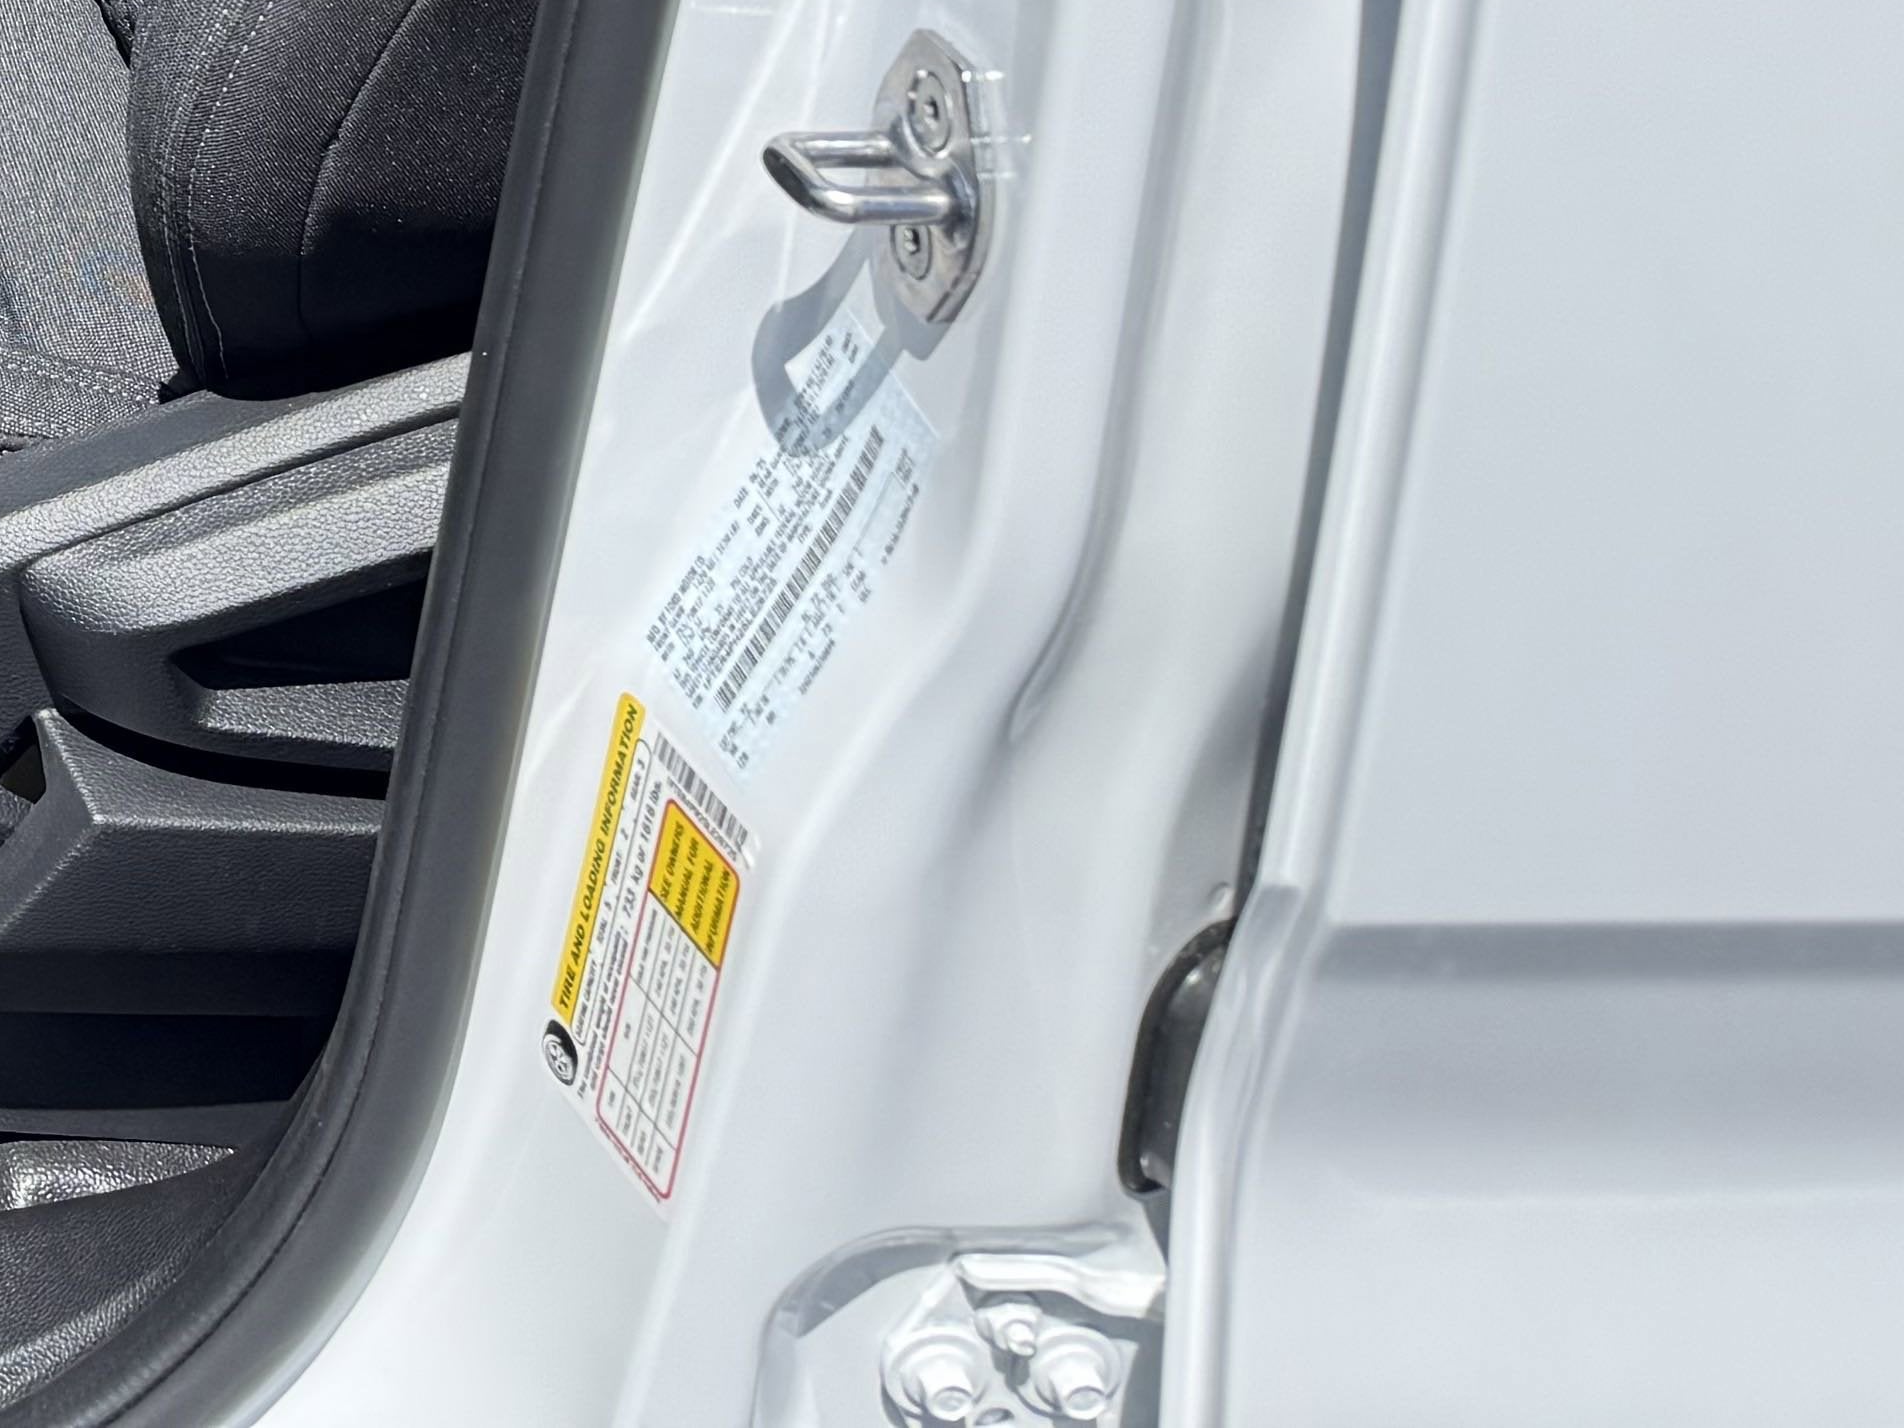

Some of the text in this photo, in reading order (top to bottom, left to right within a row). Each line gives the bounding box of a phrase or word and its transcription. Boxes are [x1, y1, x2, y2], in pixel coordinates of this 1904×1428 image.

[558, 699, 638, 1013] TIRE AND LOADING INFORMATION
